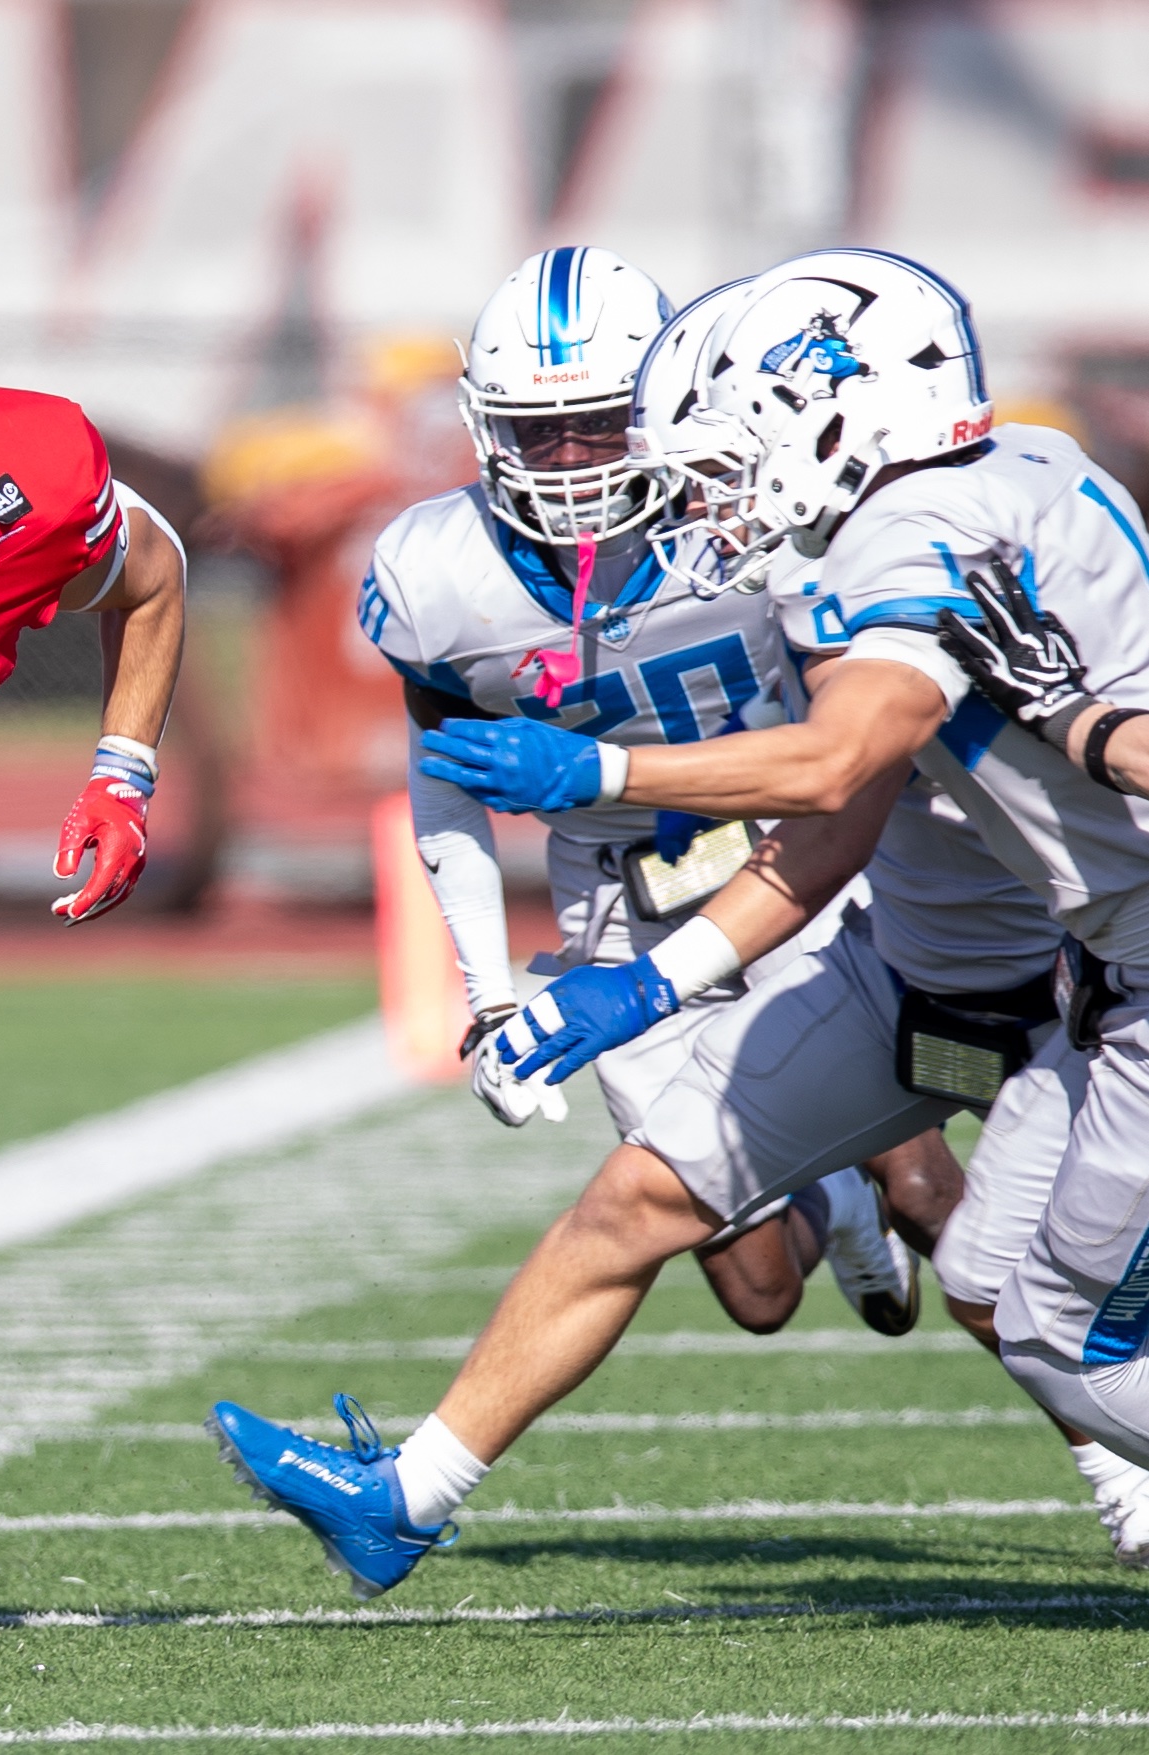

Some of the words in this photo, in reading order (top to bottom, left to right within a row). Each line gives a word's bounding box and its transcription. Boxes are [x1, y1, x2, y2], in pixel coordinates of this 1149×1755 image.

[533, 370, 590, 385] Riddell
[1102, 1236, 1149, 1321] WILDC
[276, 1449, 364, 1496] PHENOM
